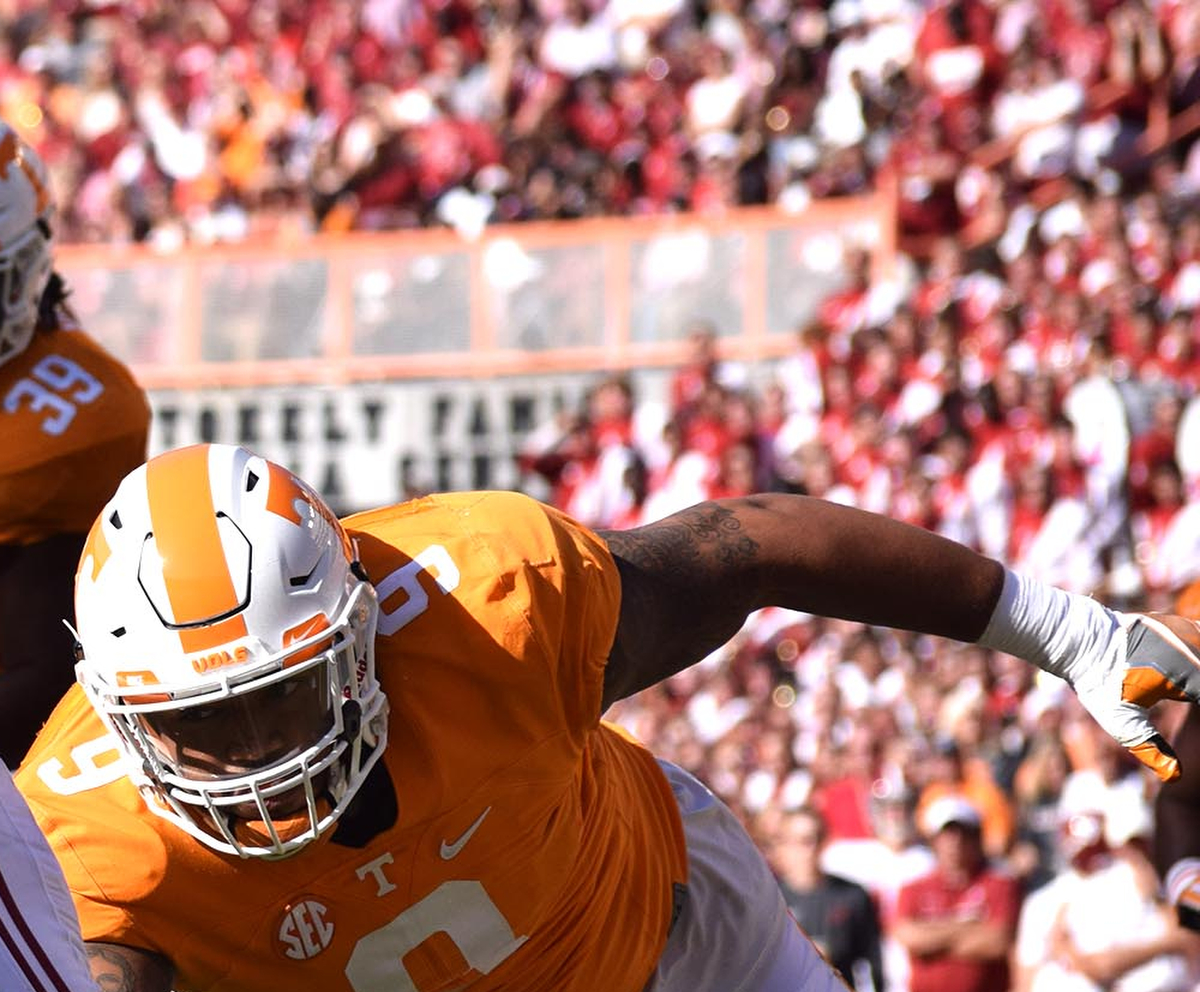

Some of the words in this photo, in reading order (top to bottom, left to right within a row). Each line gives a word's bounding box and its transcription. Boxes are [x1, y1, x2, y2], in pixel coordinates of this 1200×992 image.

[3, 354, 104, 436] 39
[191, 646, 249, 675] VOLS
[355, 852, 398, 897] T
[279, 901, 335, 960] SEC
